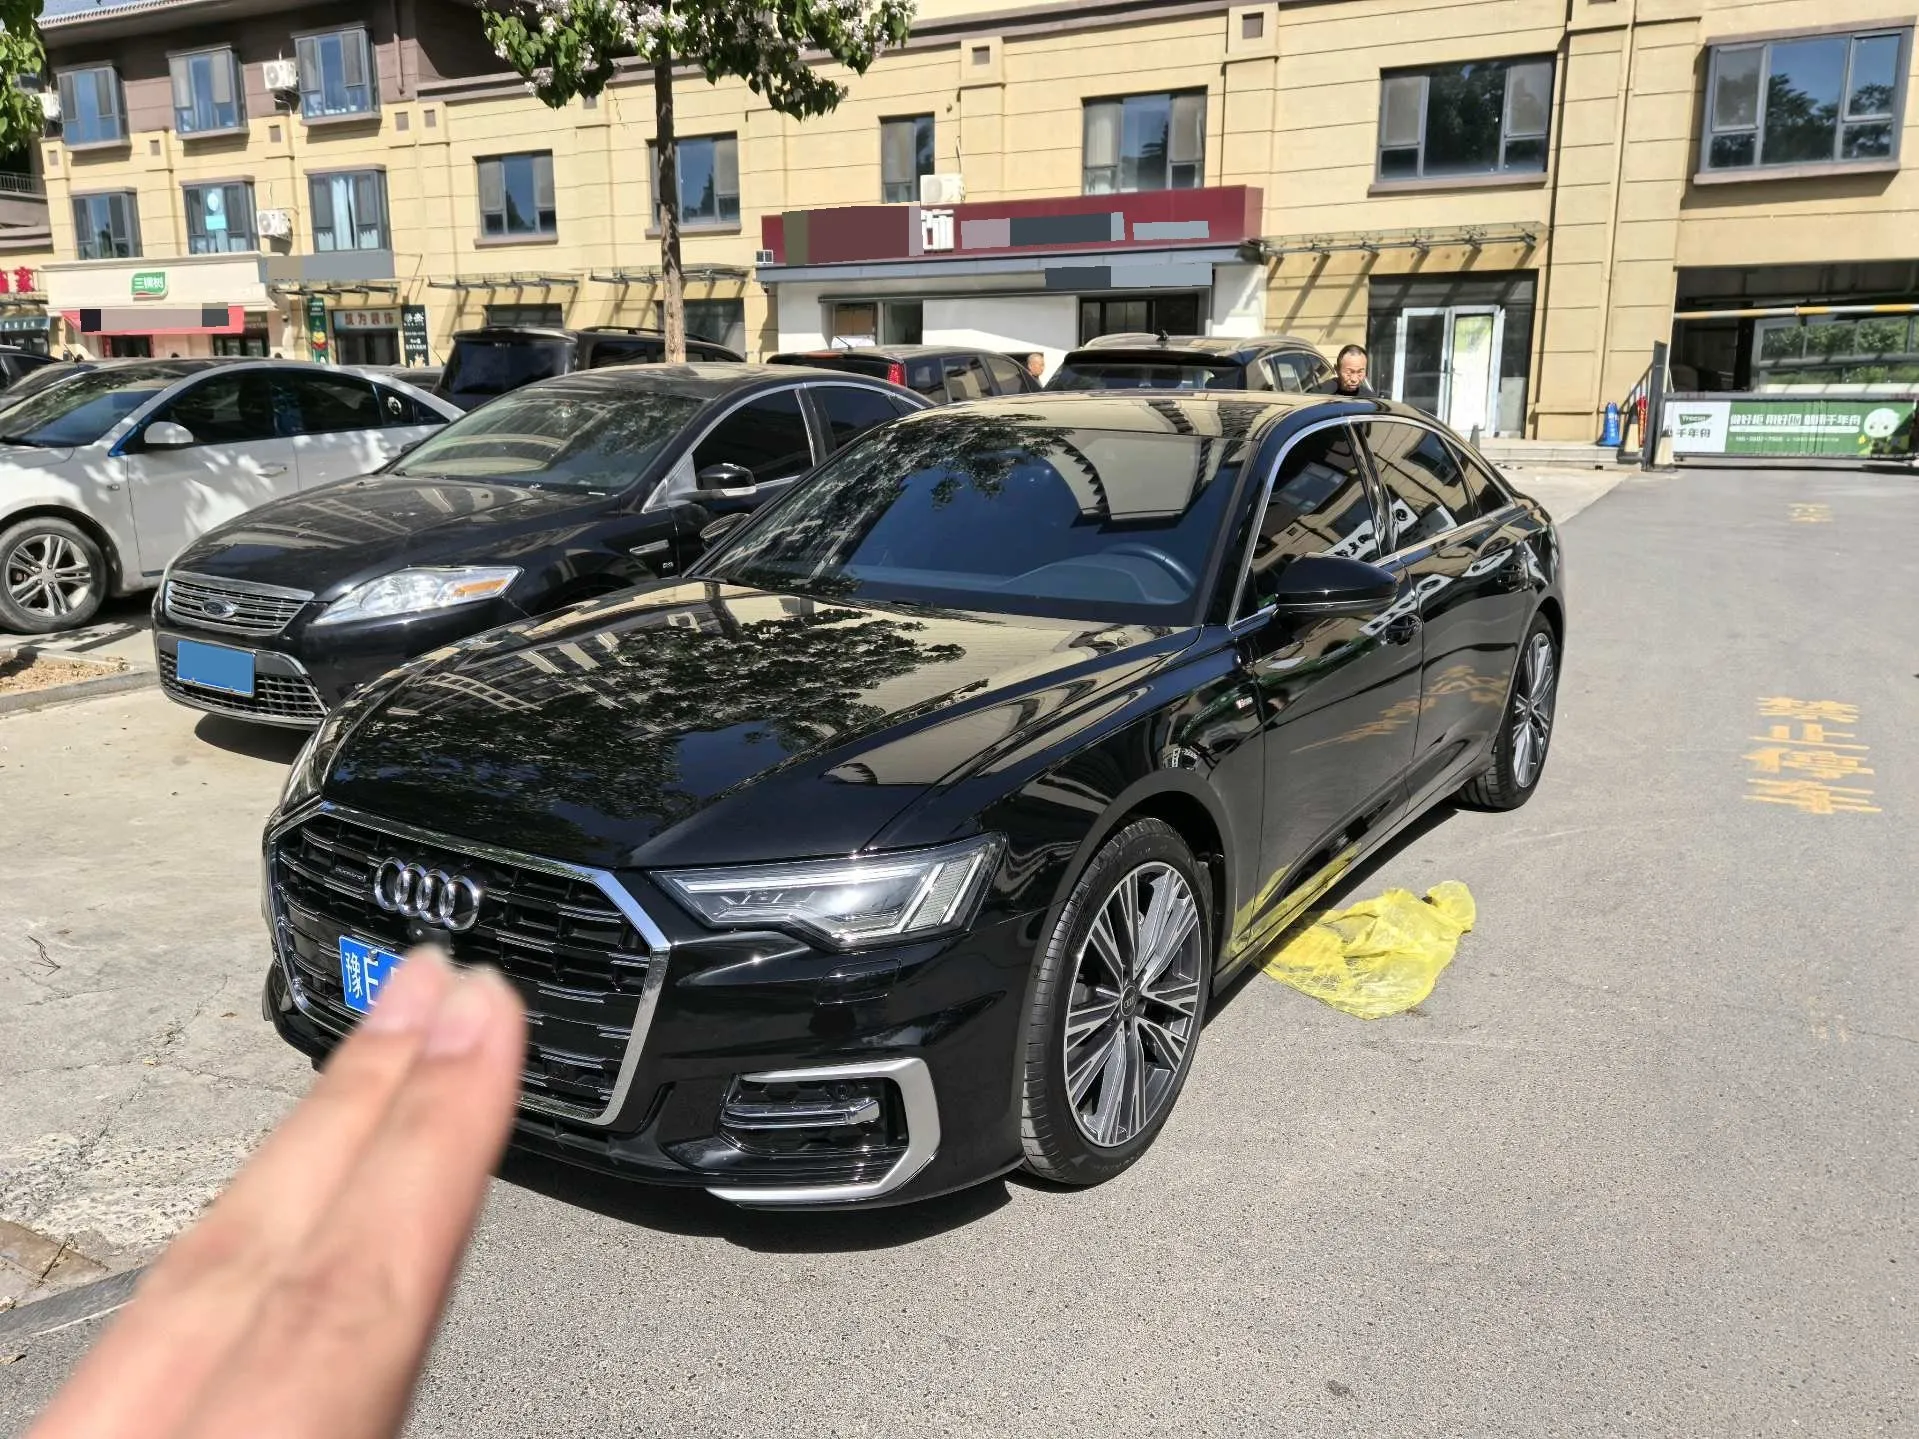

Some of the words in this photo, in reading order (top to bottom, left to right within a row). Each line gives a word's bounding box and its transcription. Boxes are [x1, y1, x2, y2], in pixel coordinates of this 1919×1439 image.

[1675, 427, 1711, 438] 千年舟
[344, 951, 398, 1006] 豫E
